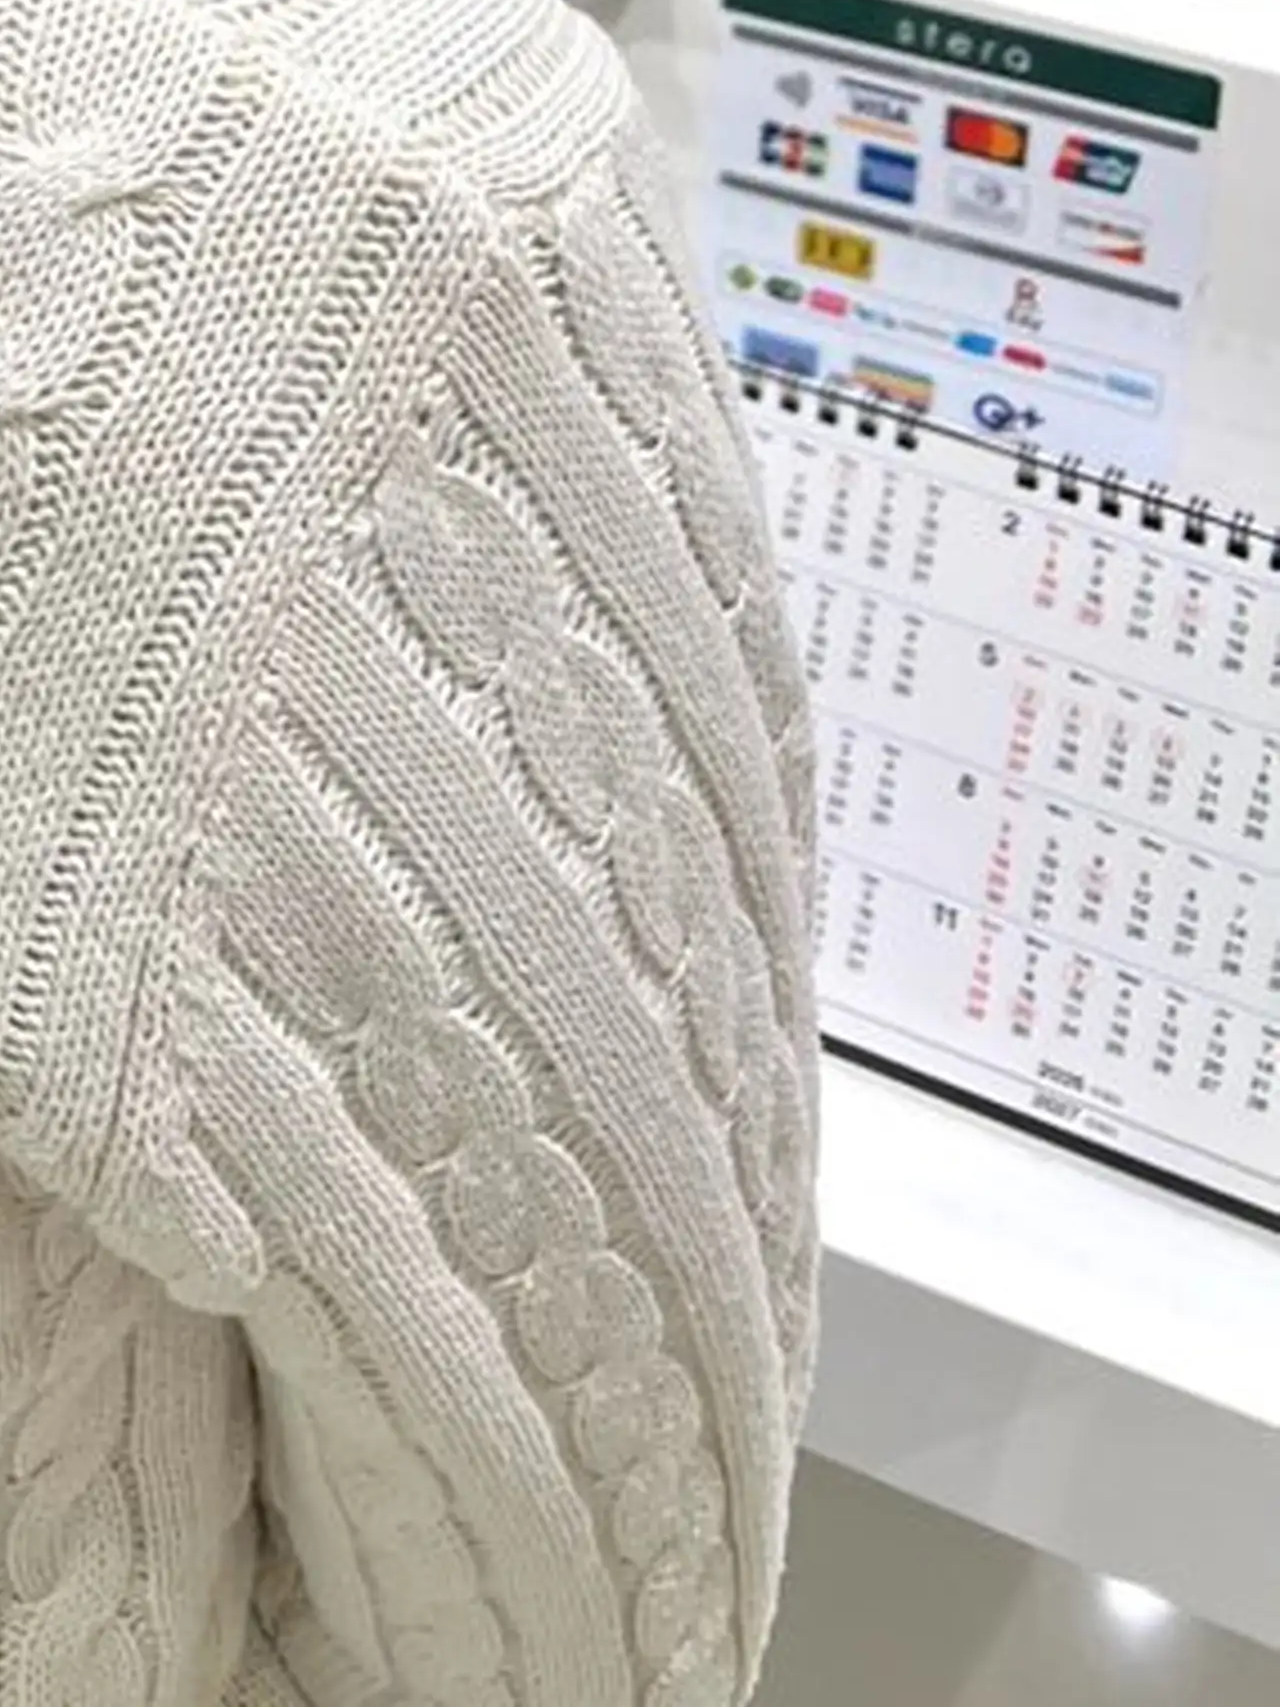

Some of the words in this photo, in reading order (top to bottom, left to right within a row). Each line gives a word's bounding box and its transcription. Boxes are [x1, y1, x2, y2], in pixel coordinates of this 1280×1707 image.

[896, 18, 1032, 74] stera
[1001, 509, 1022, 537] 2
[933, 901, 959, 932] 11
